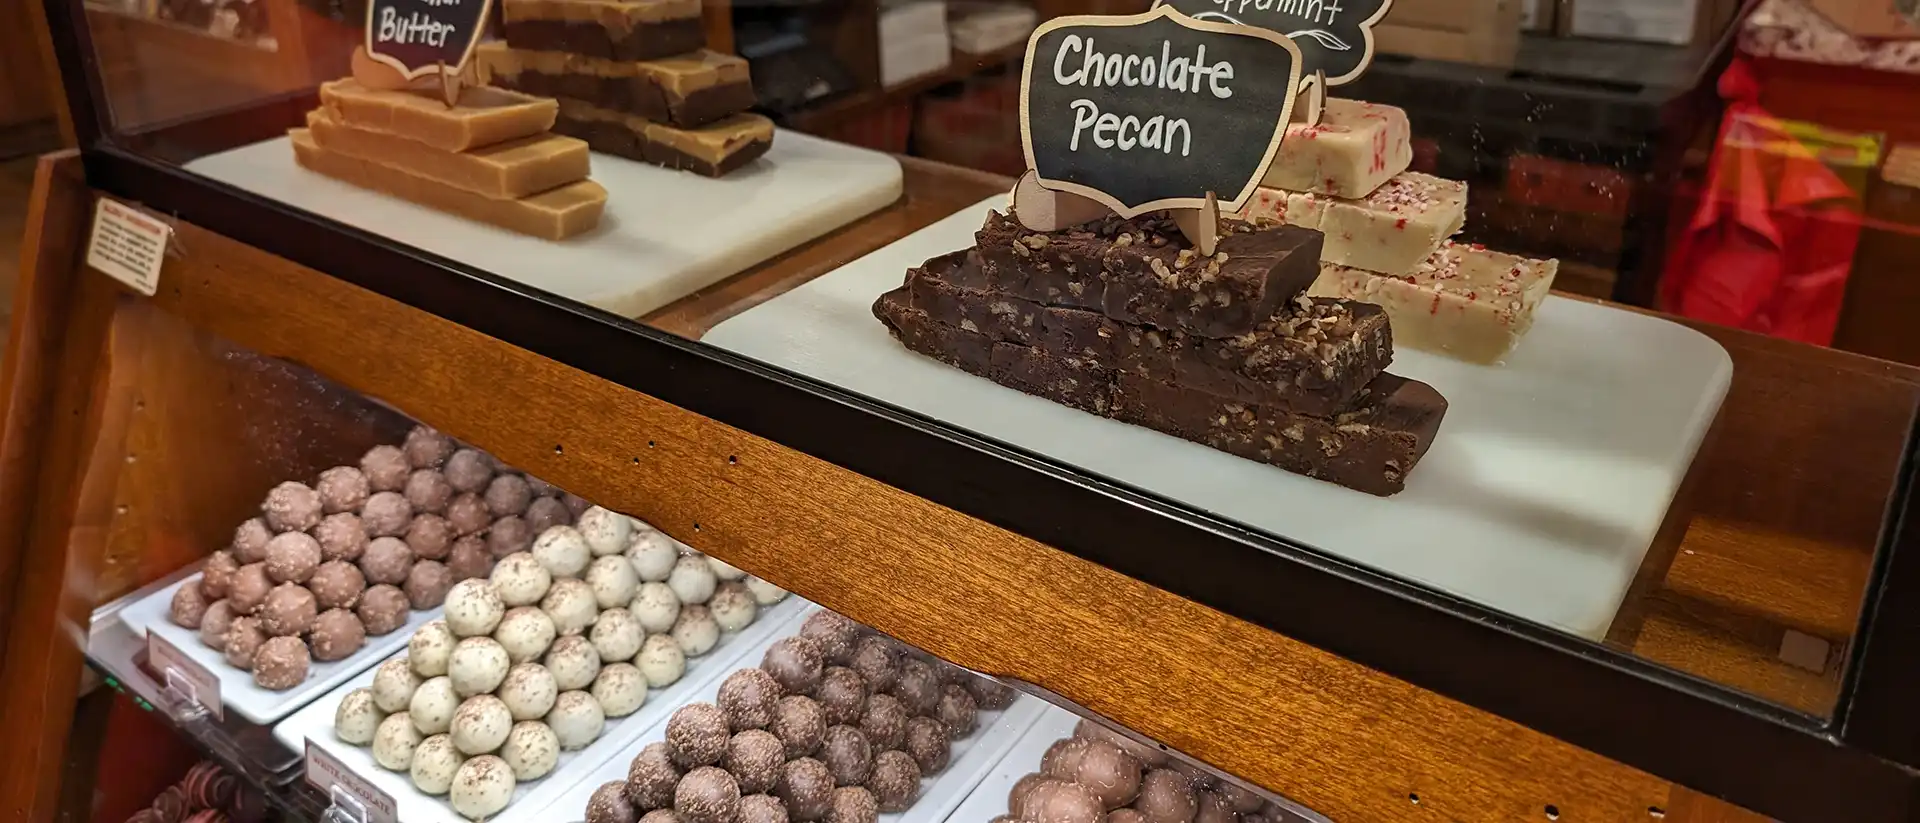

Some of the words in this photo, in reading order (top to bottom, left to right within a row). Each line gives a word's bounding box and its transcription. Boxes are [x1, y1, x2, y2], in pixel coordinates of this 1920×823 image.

[378, 6, 456, 48] Butter
[1053, 34, 1234, 98] Chocolate
[1069, 98, 1191, 156] Pecan
[312, 756, 341, 779] WHITE
